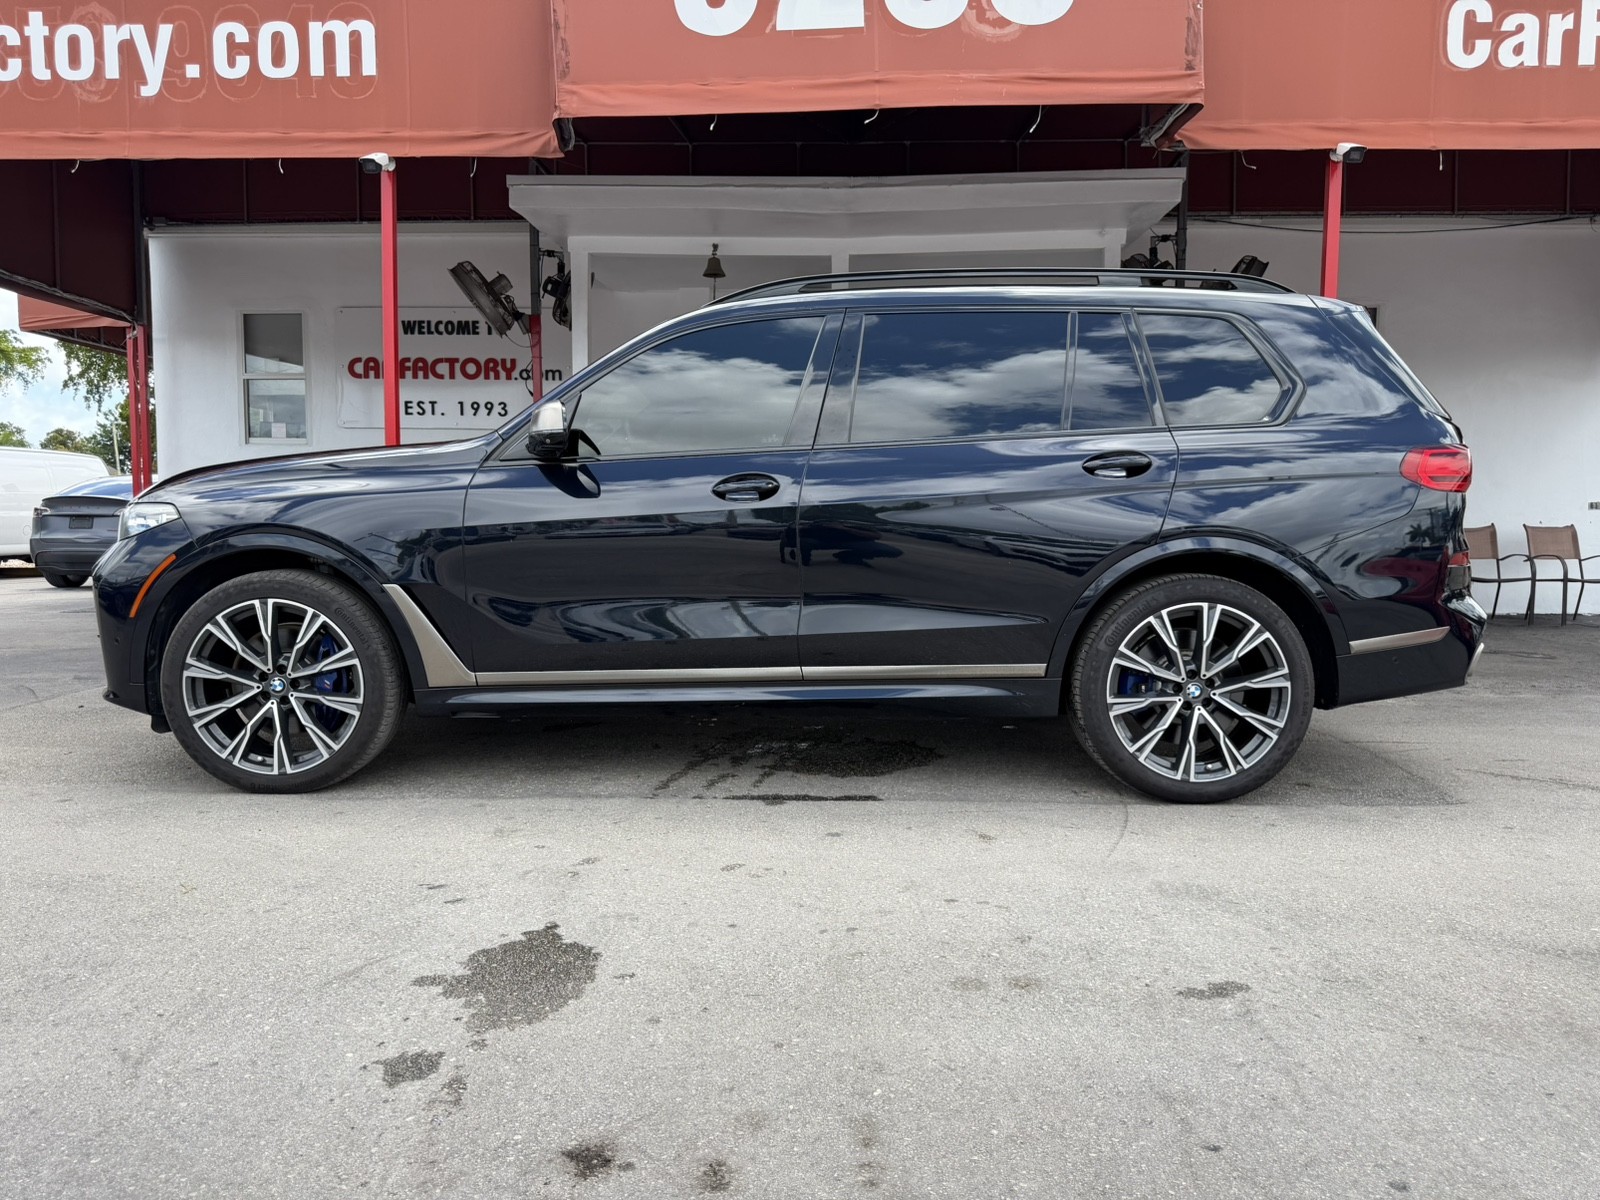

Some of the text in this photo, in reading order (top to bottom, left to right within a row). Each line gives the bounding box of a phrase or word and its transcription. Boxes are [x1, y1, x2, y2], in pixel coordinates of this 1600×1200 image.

[401, 320, 480, 336] WELCOME
[347, 356, 563, 381] CAFACTORY.cm
[404, 401, 508, 417] EST. 1993
